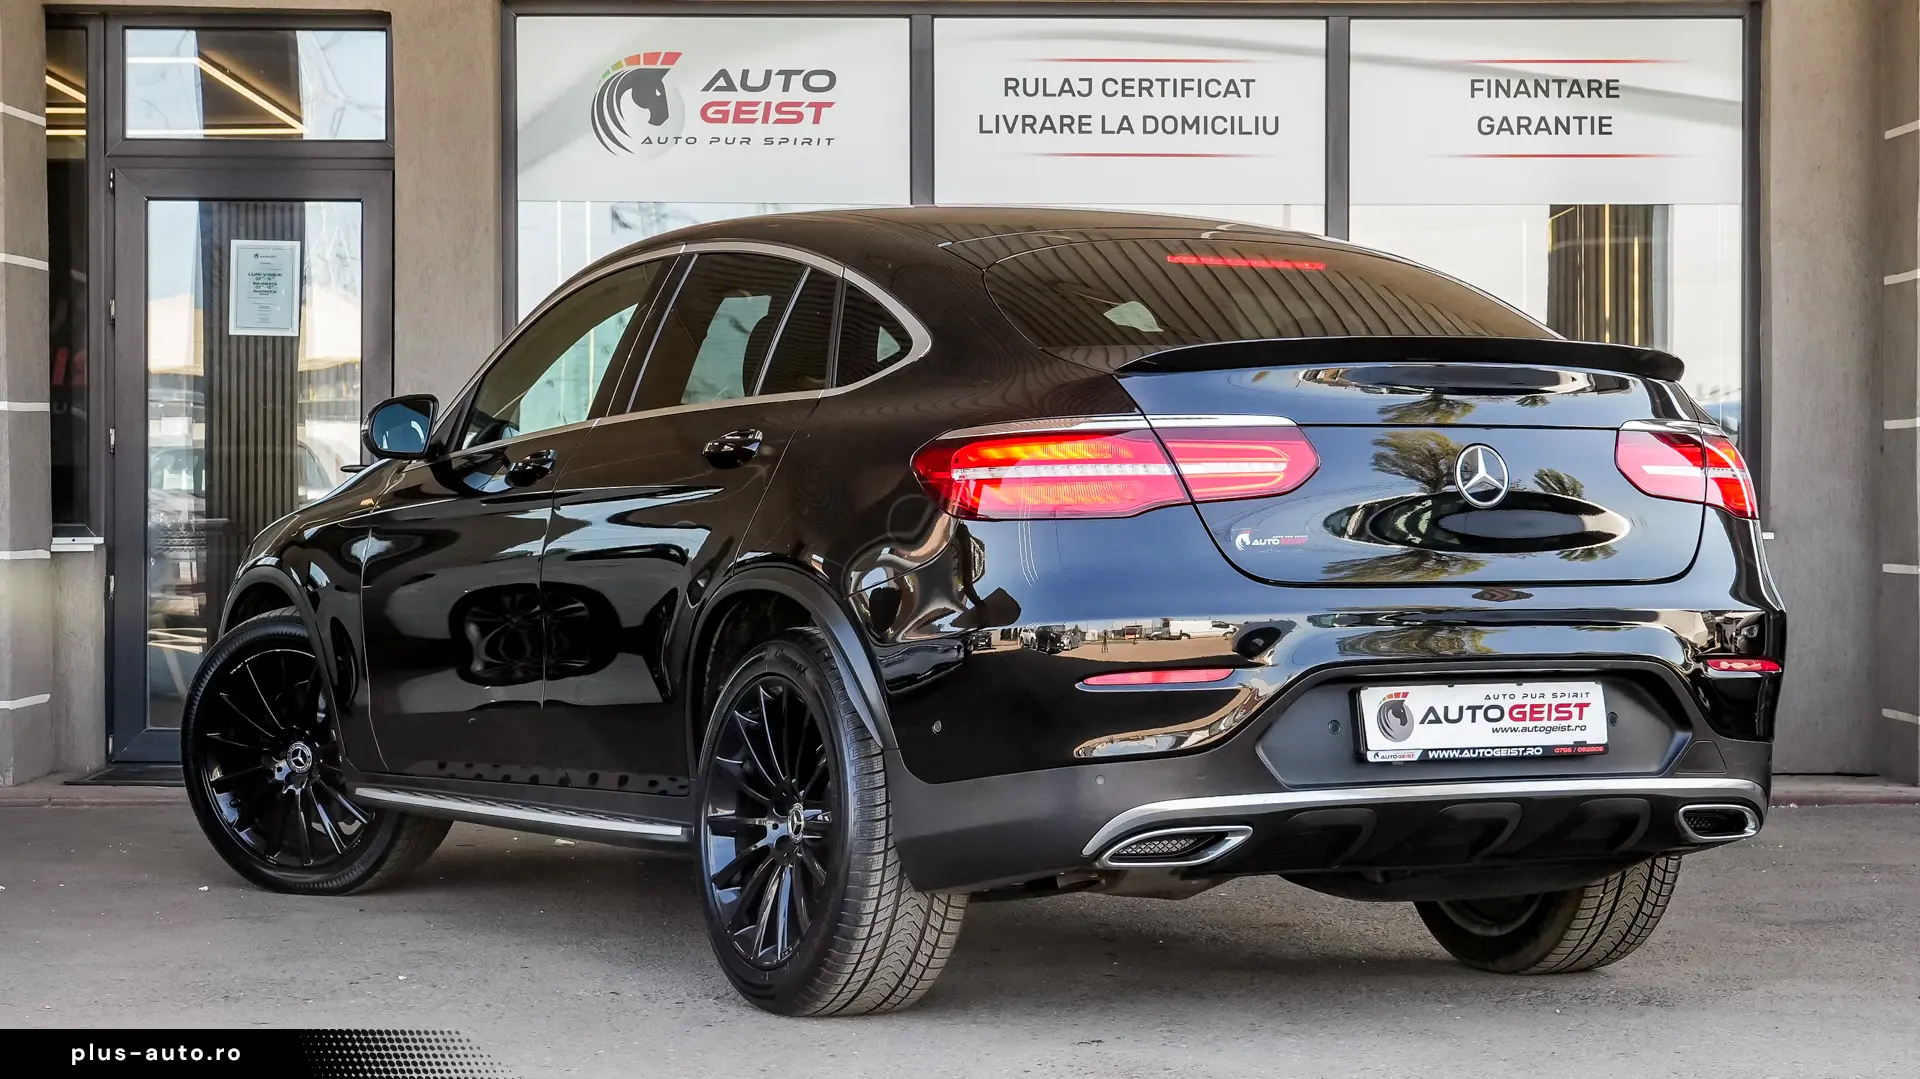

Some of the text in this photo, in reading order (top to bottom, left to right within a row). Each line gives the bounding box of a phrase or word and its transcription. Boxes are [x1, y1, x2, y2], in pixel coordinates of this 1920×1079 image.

[700, 68, 837, 93] AUTO
[1003, 77, 1256, 98] RULAJ CERTIFICAT
[1470, 78, 1620, 99] FINANTARE
[699, 101, 837, 125] GEIST
[978, 114, 1279, 136] LIVRARE LA DOMICILIU
[1477, 115, 1613, 136] GARANTIE
[641, 136, 835, 146] AUTO PUR SPIRIT
[1551, 691, 1591, 699] SPIRIT
[1491, 723, 1587, 734] www.autogeist.ro
[1428, 747, 1543, 759] WWW.AUTOGEIST.RO
